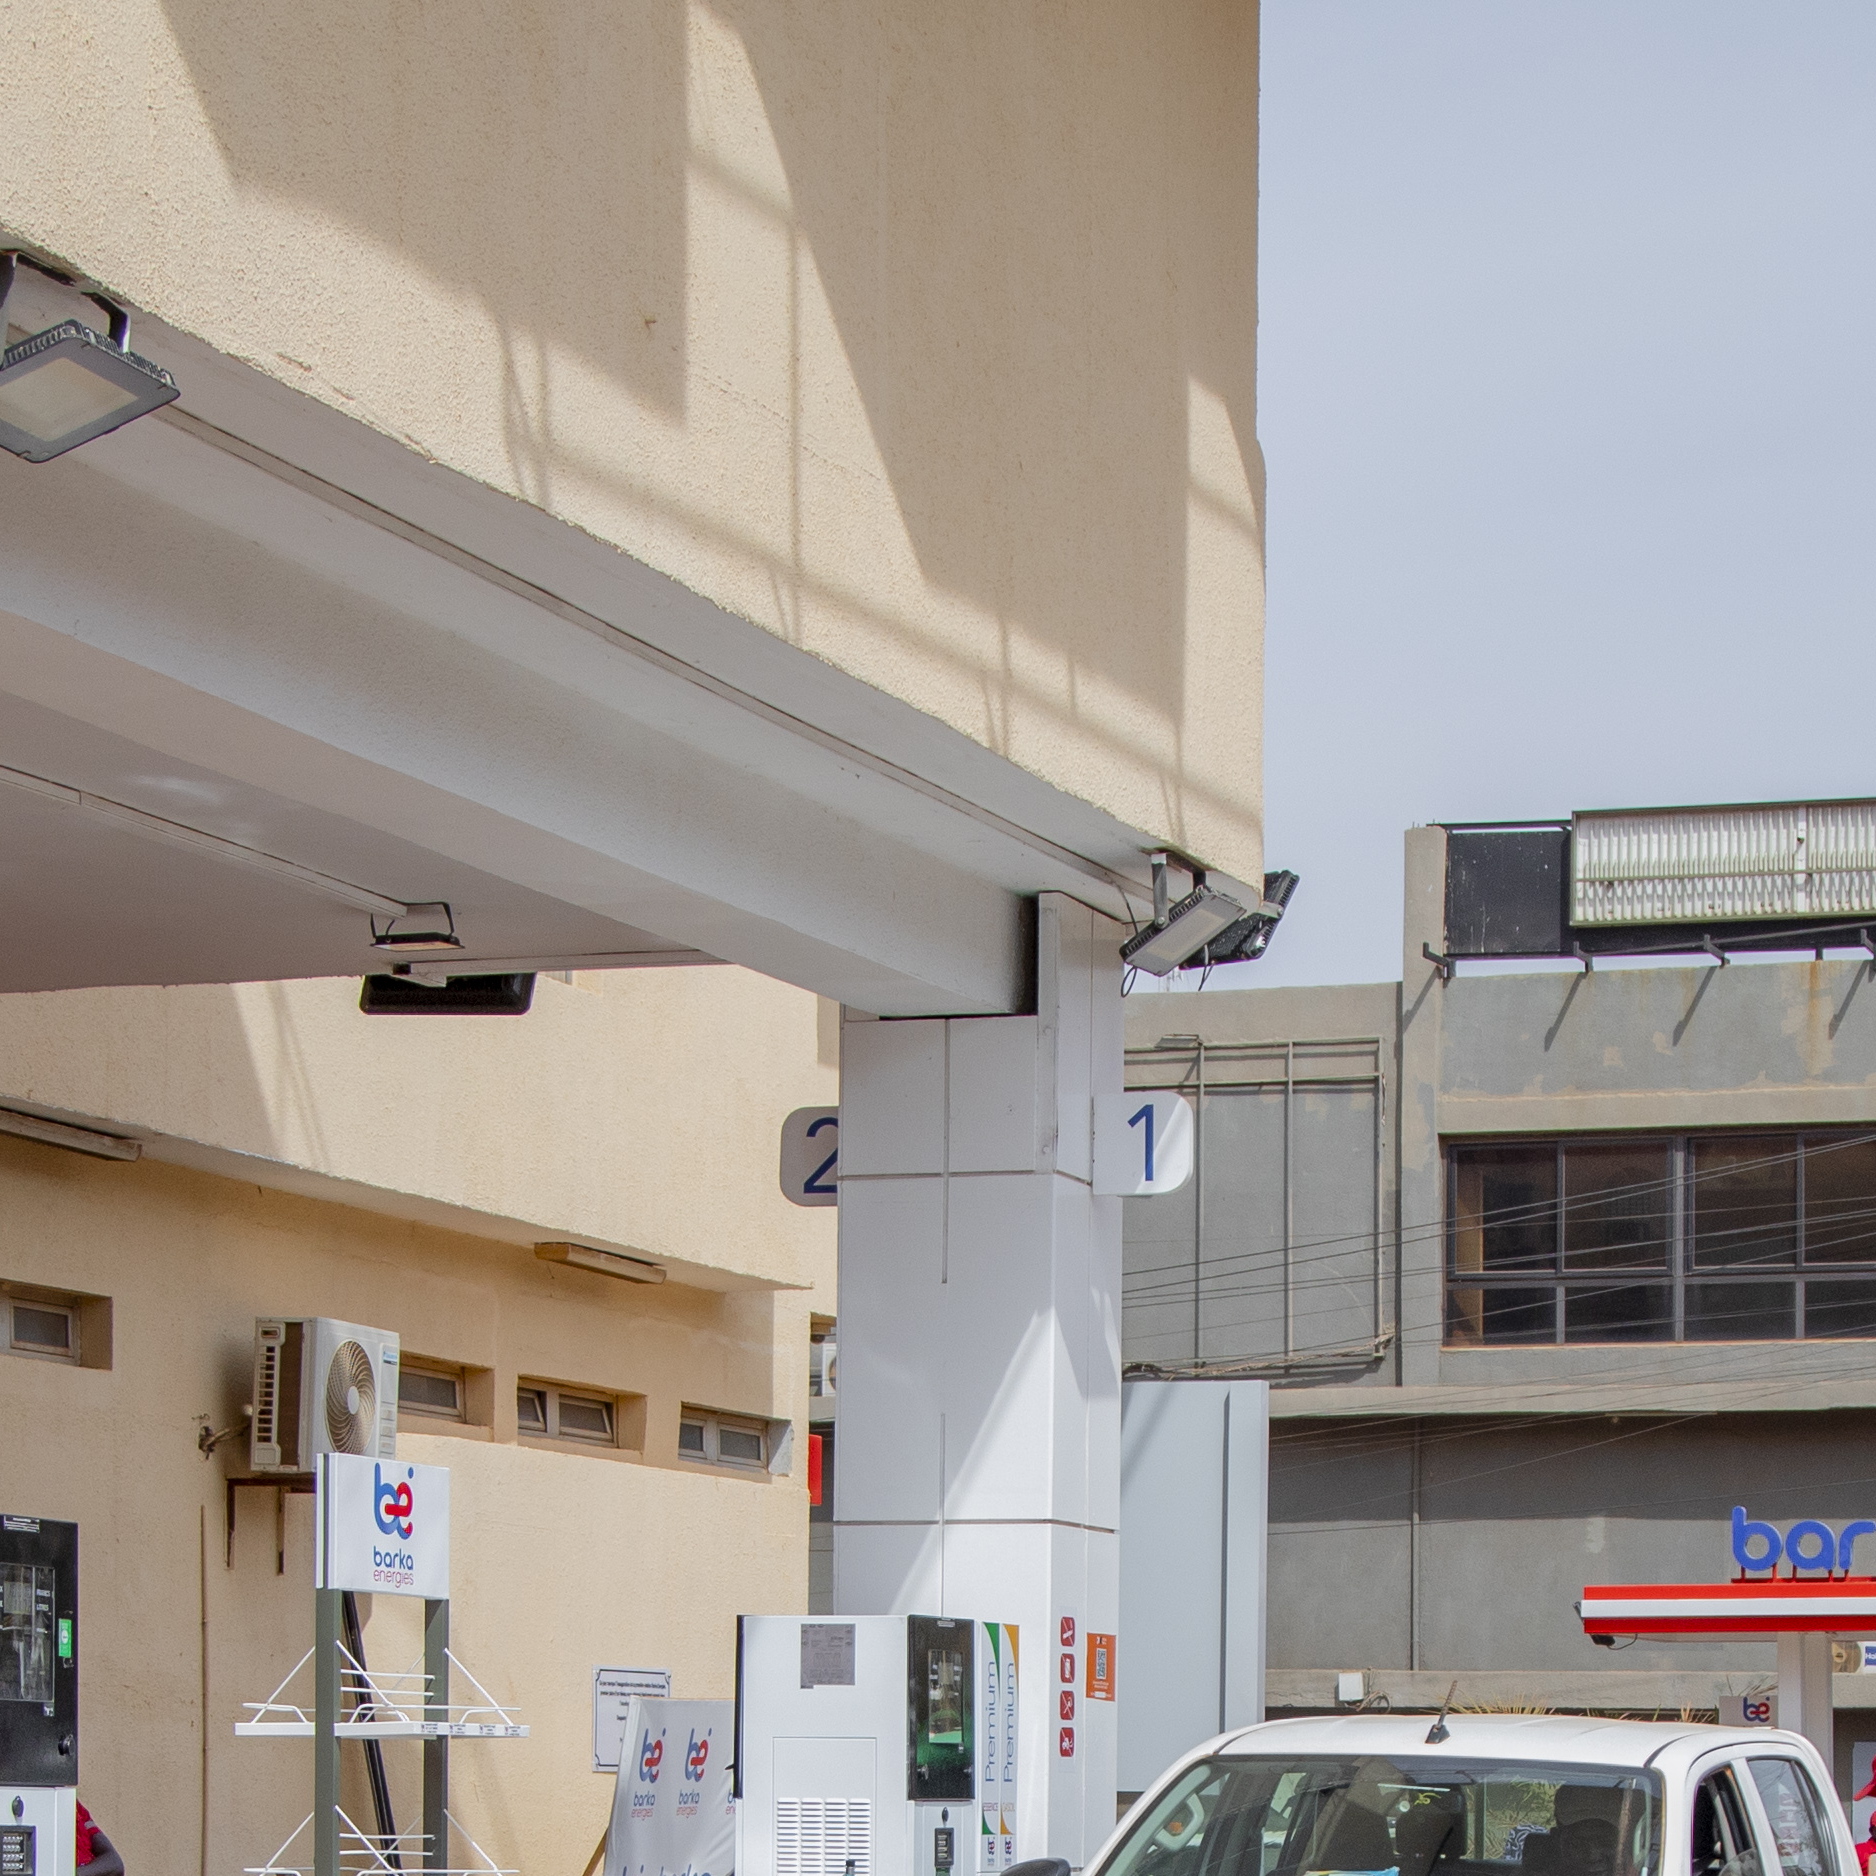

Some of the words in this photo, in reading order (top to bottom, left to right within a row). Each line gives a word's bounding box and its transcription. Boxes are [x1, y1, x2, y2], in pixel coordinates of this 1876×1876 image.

[804, 1117, 838, 1194] 2
[1127, 1103, 1154, 1182] 1
[373, 1545, 414, 1571] barka
[373, 1569, 414, 1589] energies
[985, 1661, 996, 1782] Premium
[1003, 1662, 1015, 1782] Premium
[633, 1790, 656, 1807] barka
[677, 1789, 700, 1806] barka
[631, 1807, 653, 1821] energies
